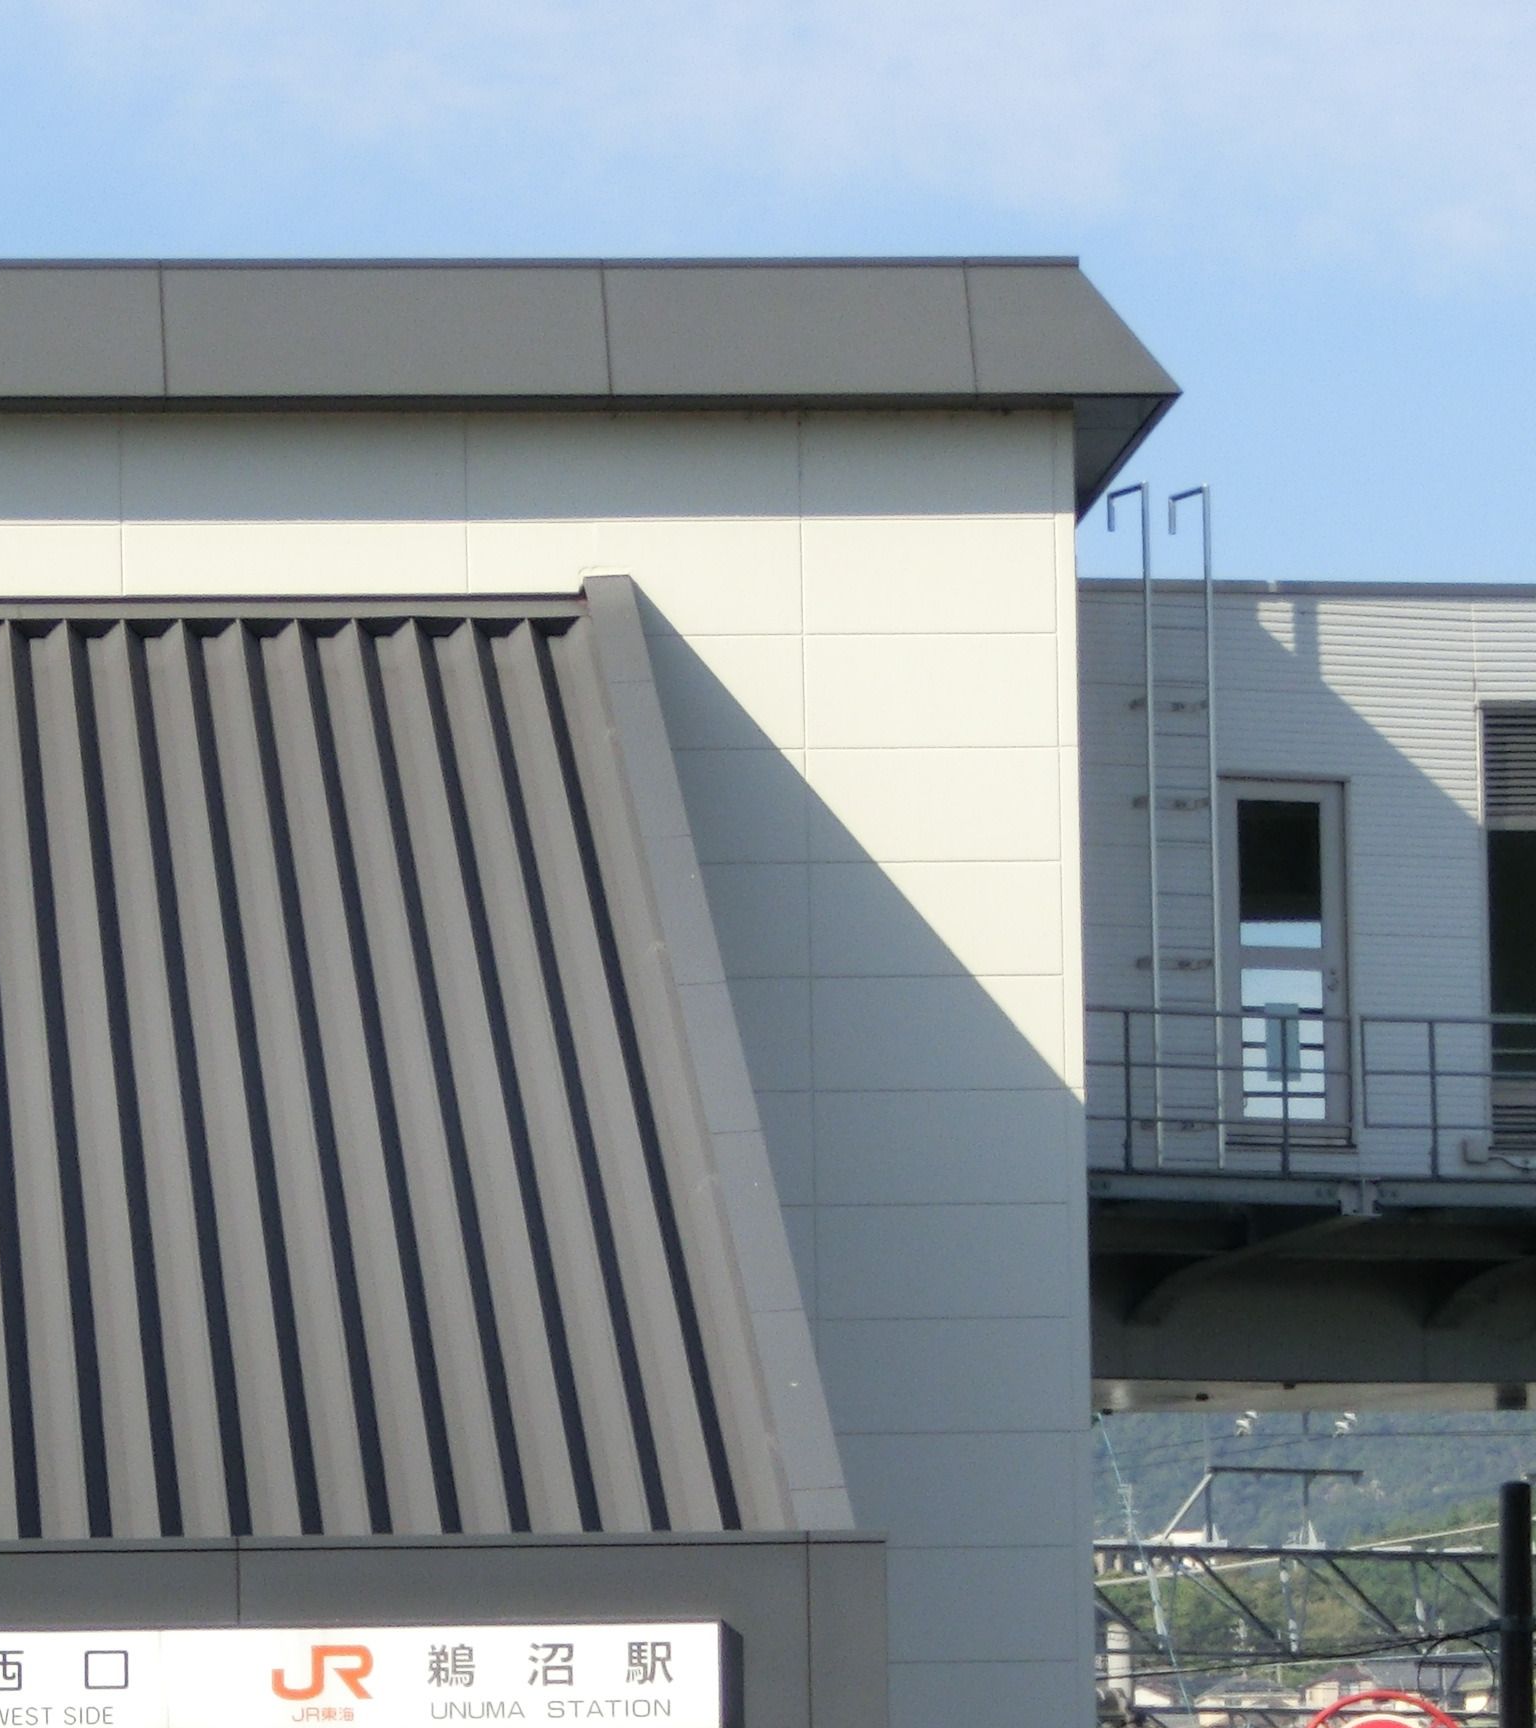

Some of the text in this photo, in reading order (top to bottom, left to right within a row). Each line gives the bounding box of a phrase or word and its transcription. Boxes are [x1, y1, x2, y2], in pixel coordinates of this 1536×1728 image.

[272, 1645, 372, 1700] JR
[428, 1642, 673, 1687] 鵜沼駅
[64, 1707, 113, 1725] SIDE
[291, 1706, 354, 1722] JR東海
[431, 1699, 670, 1719] UNUMA STATION
